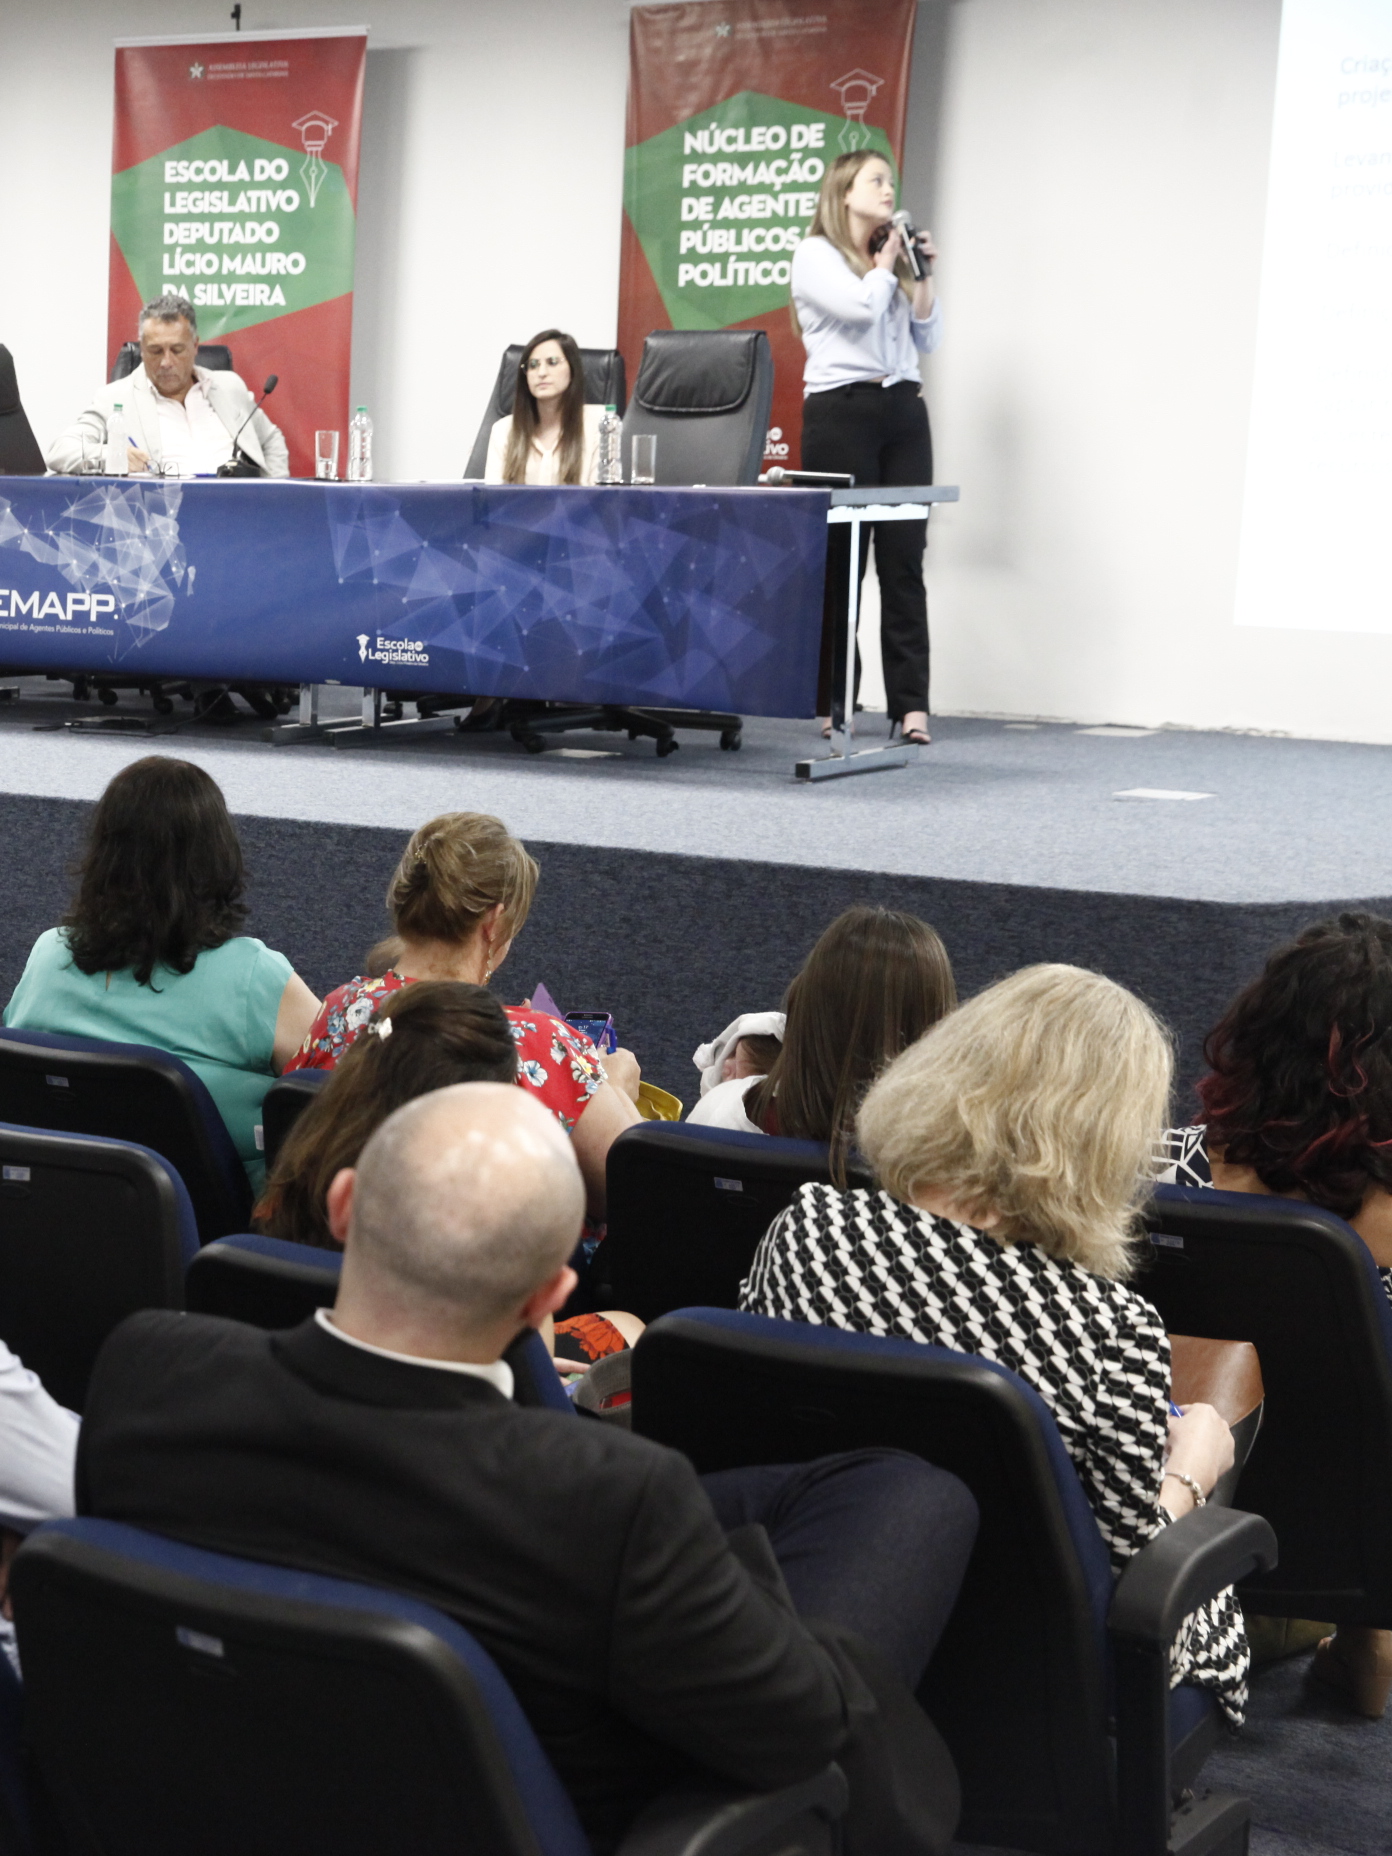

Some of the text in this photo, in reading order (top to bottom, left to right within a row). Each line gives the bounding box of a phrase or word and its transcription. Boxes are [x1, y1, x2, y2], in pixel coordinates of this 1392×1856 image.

[683, 122, 825, 155] NÚCLEO DE
[164, 158, 289, 183] ESCOLA DO
[682, 152, 825, 190] FORMAÇÃO
[164, 189, 300, 214] LEGISLATIVO
[681, 191, 820, 221] DE AGENTE
[163, 221, 280, 245] DEPUTADO
[679, 223, 802, 254] PÚBLICOS
[163, 246, 306, 275] LÍCIO MAURO
[193, 283, 286, 306] SILVEIRA
[20, 623, 28, 631] de
[29, 625, 55, 633] Agentes
[56, 625, 81, 634] Públicos
[88, 626, 114, 636] Políticos
[368, 648, 429, 664] Legislativo
[376, 637, 414, 650] Escola
